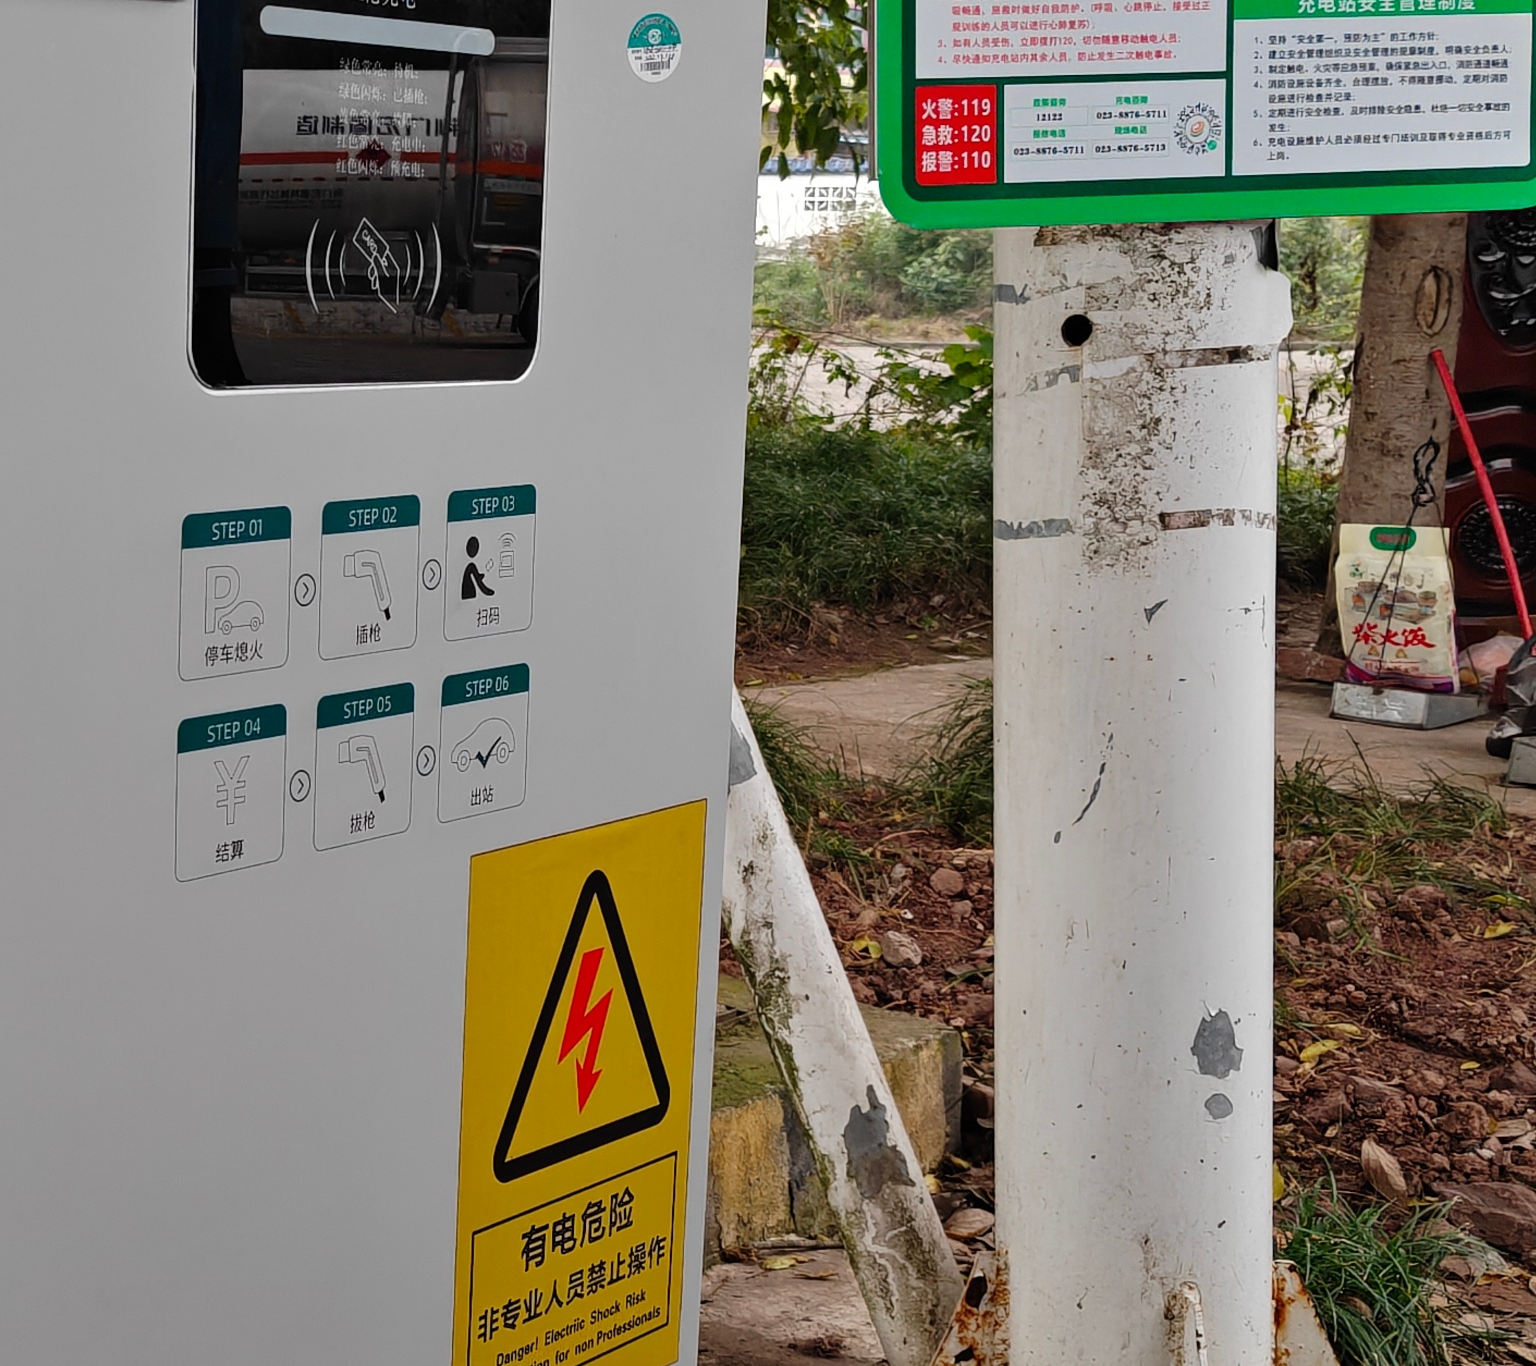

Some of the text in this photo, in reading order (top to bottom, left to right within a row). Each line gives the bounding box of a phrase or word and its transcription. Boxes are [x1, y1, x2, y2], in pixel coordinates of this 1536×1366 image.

[922, 97, 992, 121] 火警:119
[1096, 110, 1167, 120] 023-8876-5711
[921, 123, 992, 146] 急救:120
[1013, 146, 1085, 156] 023-8876-5711
[1095, 143, 1167, 154] 023-8876-5713
[921, 149, 992, 174] 报警:110
[348, 506, 398, 526] STEP 02
[471, 495, 515, 515] STEP 03
[211, 518, 264, 540] STEP 01
[475, 607, 500, 628] 扫码
[354, 624, 381, 645] 插枪
[204, 639, 264, 667] 停车熄火
[465, 675, 510, 697] STEP 06
[343, 696, 392, 719] STEP 05
[207, 717, 261, 743] STEP 04
[470, 788, 495, 807] 出站
[349, 811, 376, 833] 拔枪
[214, 840, 245, 863] 结算
[521, 1186, 635, 1272] 有电危险
[477, 1235, 666, 1343] 非专业人员禁止操作
[590, 1300, 621, 1325] Shock
[626, 1289, 646, 1310] Risk
[555, 1348, 570, 1365] for
[574, 1338, 594, 1356] non
[596, 1306, 661, 1346] Professionals
